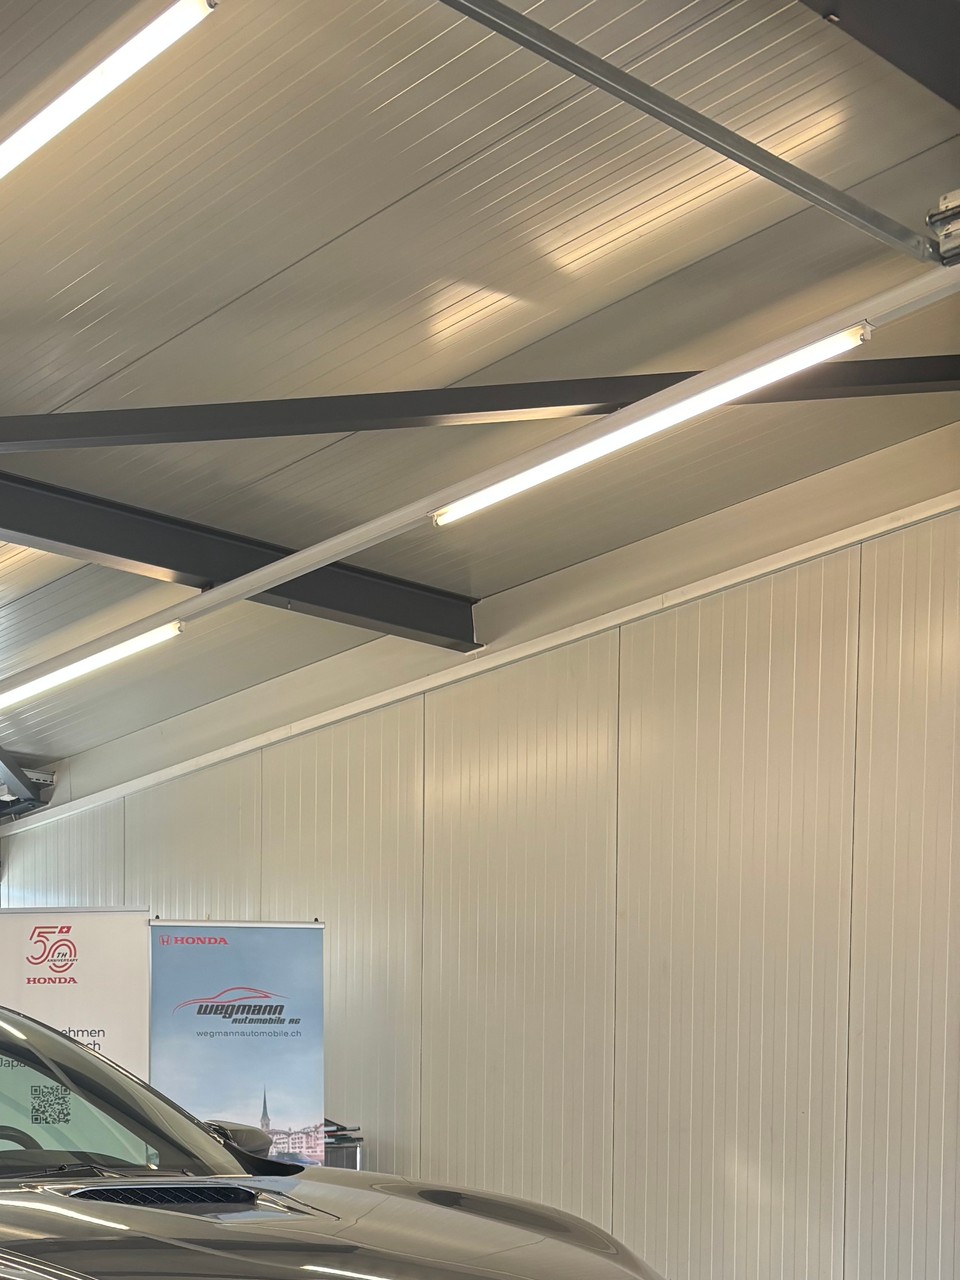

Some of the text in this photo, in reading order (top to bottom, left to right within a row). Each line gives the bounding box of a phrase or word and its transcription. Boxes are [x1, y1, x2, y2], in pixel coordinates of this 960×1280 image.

[173, 936, 228, 945] HONDA
[26, 925, 77, 974] 50
[26, 976, 78, 985] HONDA
[196, 1003, 285, 1019] wegmann
[61, 1026, 106, 1038] ehmen
[196, 1030, 302, 1039] wegmannautomobile.ch
